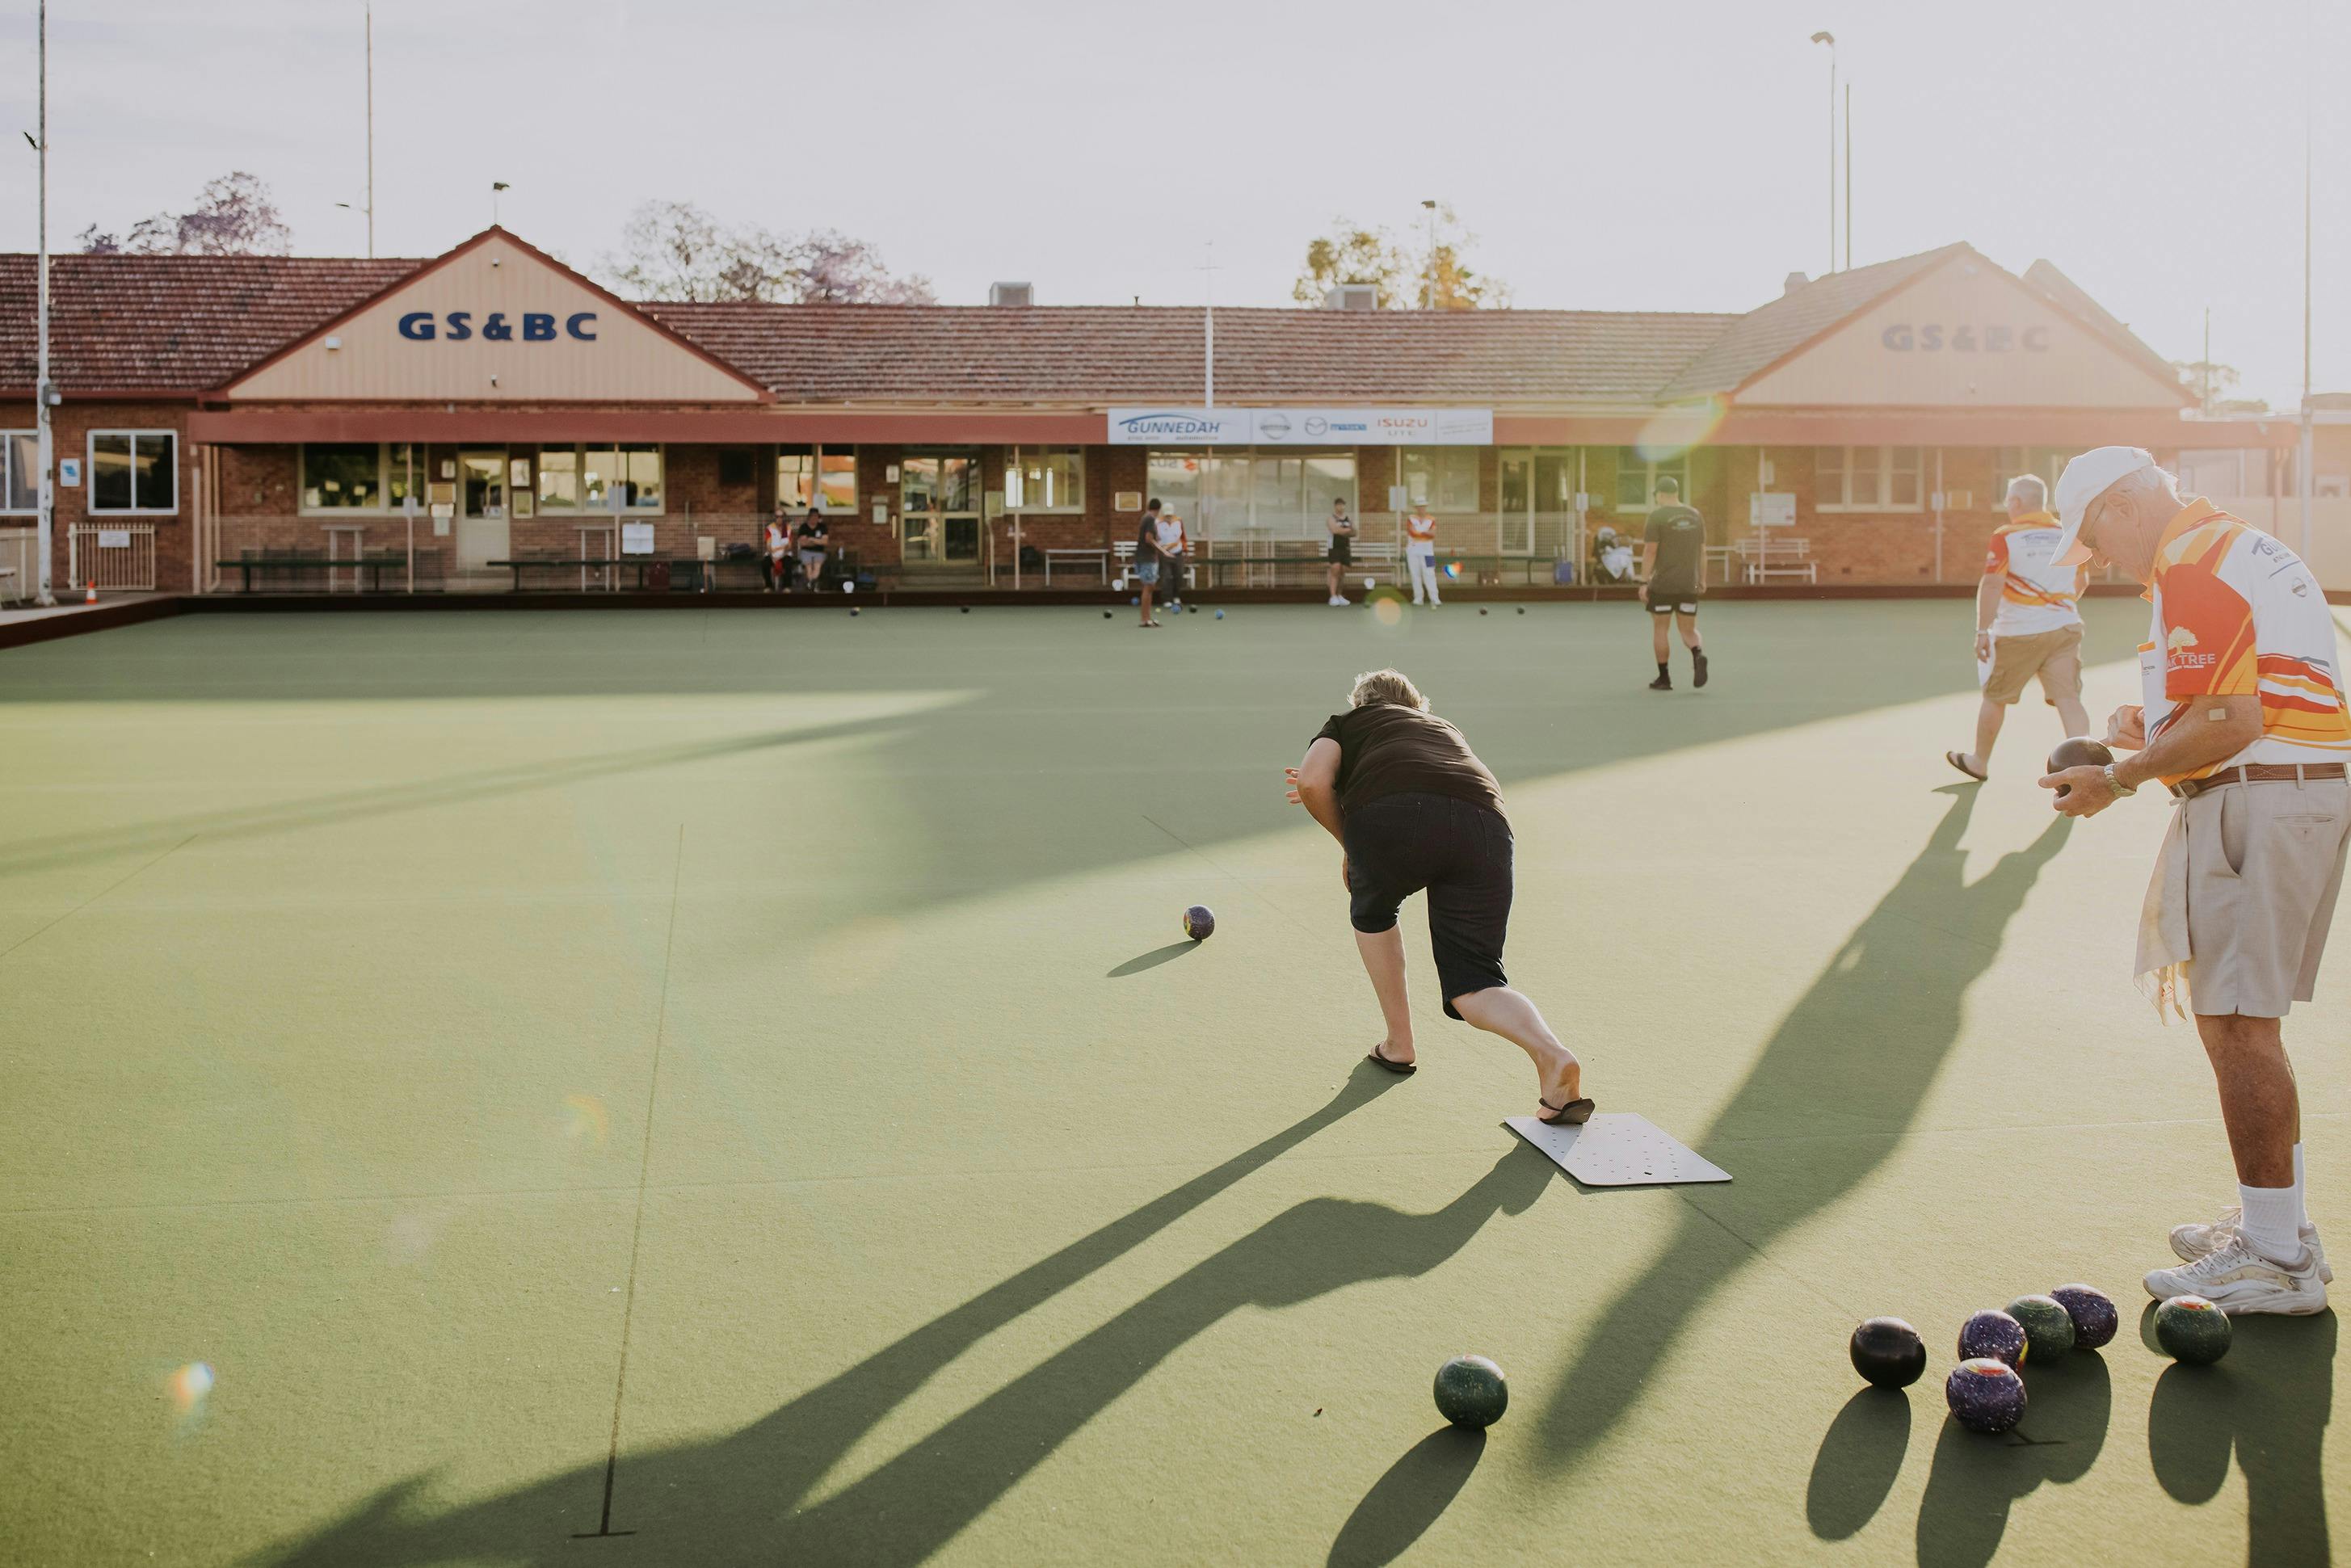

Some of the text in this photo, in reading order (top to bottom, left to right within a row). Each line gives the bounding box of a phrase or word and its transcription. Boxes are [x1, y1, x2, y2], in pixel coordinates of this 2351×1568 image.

[398, 312, 598, 341] GS&BC
[1128, 422, 1220, 434] GUNNEDAH
[1377, 418, 1428, 427] ISUZU
